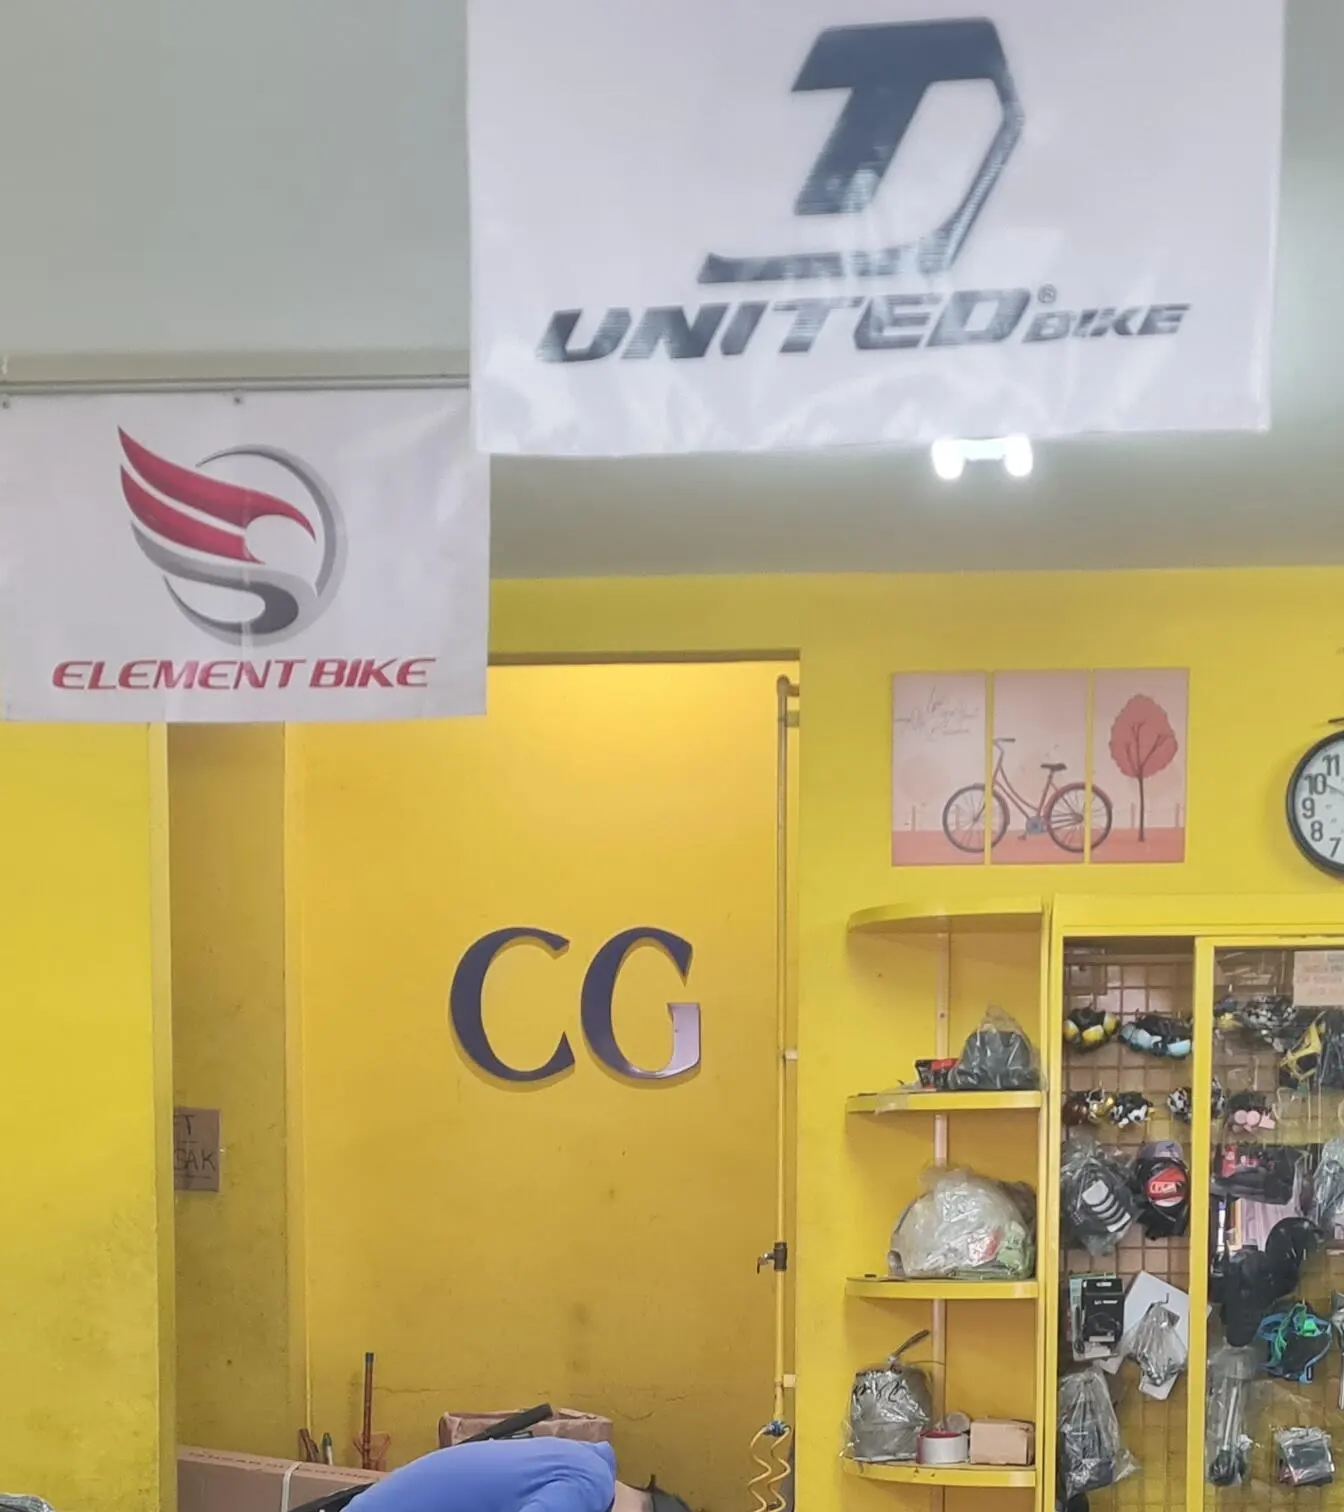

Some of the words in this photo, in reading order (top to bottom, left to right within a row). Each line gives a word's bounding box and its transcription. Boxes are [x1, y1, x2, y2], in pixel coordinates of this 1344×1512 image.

[536, 286, 1032, 364] UNITED
[1022, 302, 1191, 344] BIKE
[52, 659, 306, 690] ELEMENT
[310, 657, 437, 688] BIKE
[1323, 754, 1340, 776] 11
[1305, 773, 1327, 795] 10
[1302, 797, 1315, 819] 9
[1310, 820, 1323, 841] 8
[1330, 837, 1341, 857] 7
[450, 926, 700, 1083] CG
